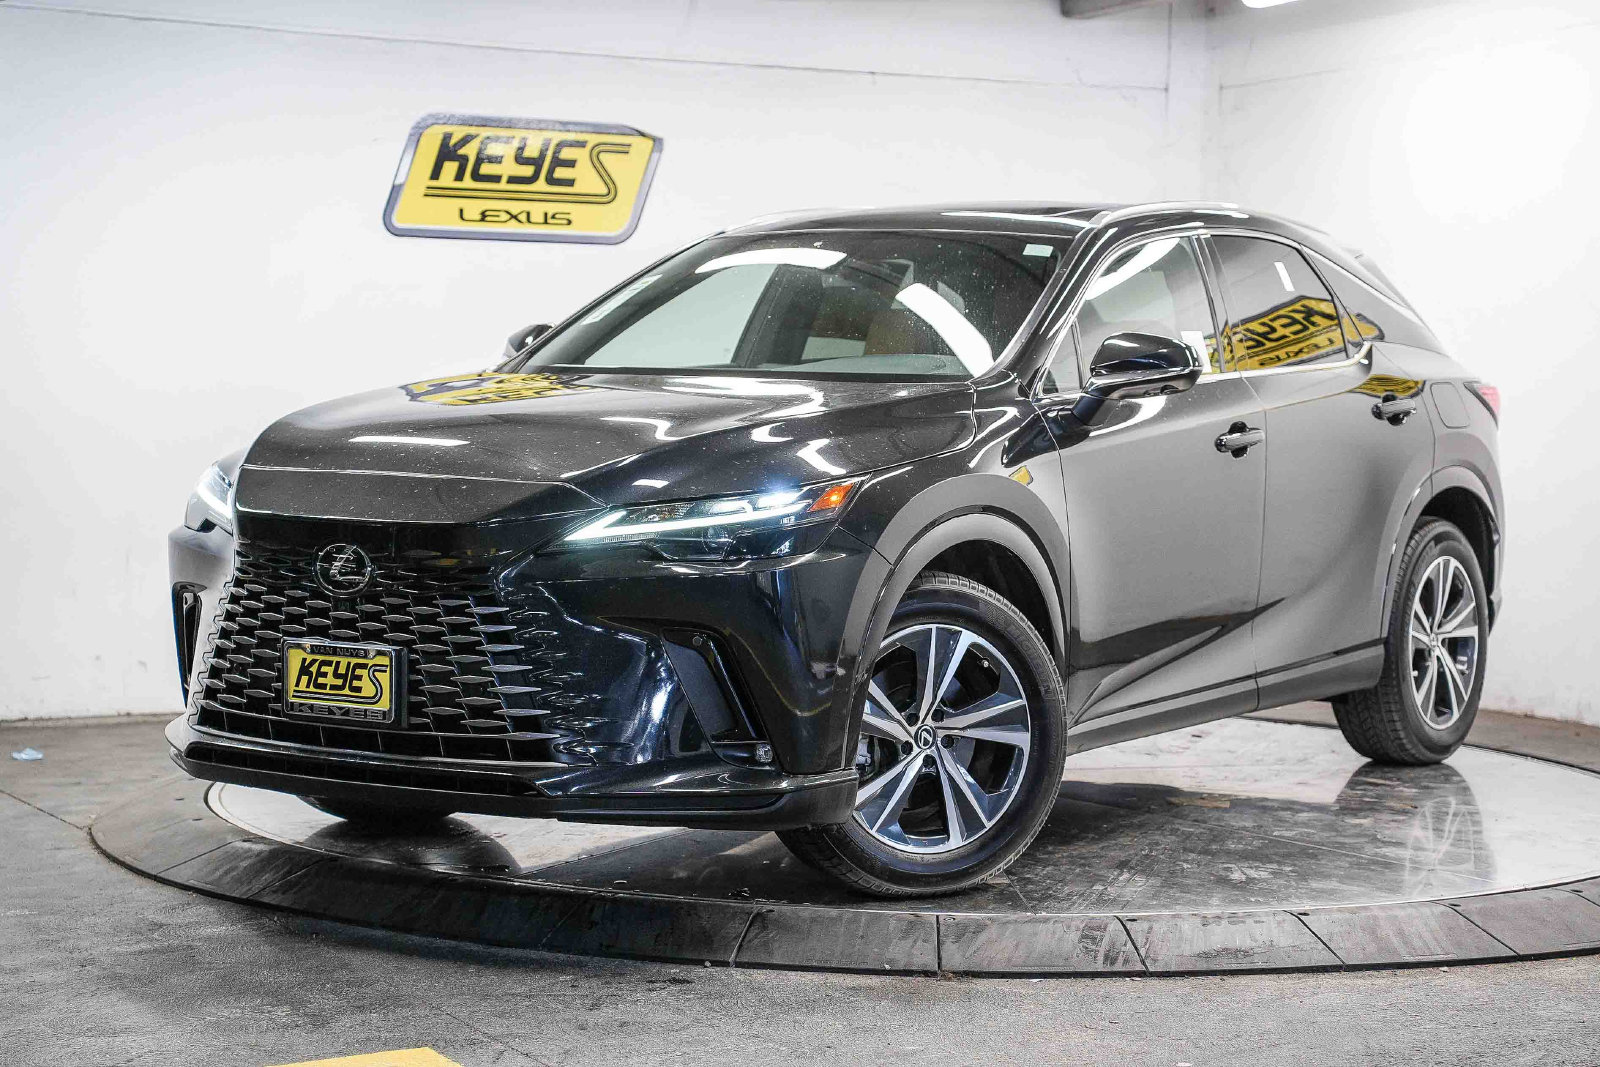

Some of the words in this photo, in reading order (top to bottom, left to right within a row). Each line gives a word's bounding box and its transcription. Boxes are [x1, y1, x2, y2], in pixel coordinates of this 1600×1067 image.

[423, 132, 632, 204] KEYES
[459, 208, 572, 226] LEXUS
[313, 646, 333, 655] VAN
[336, 648, 365, 657] NUYS
[292, 657, 389, 705] KEYES
[293, 702, 384, 720] KEYES
